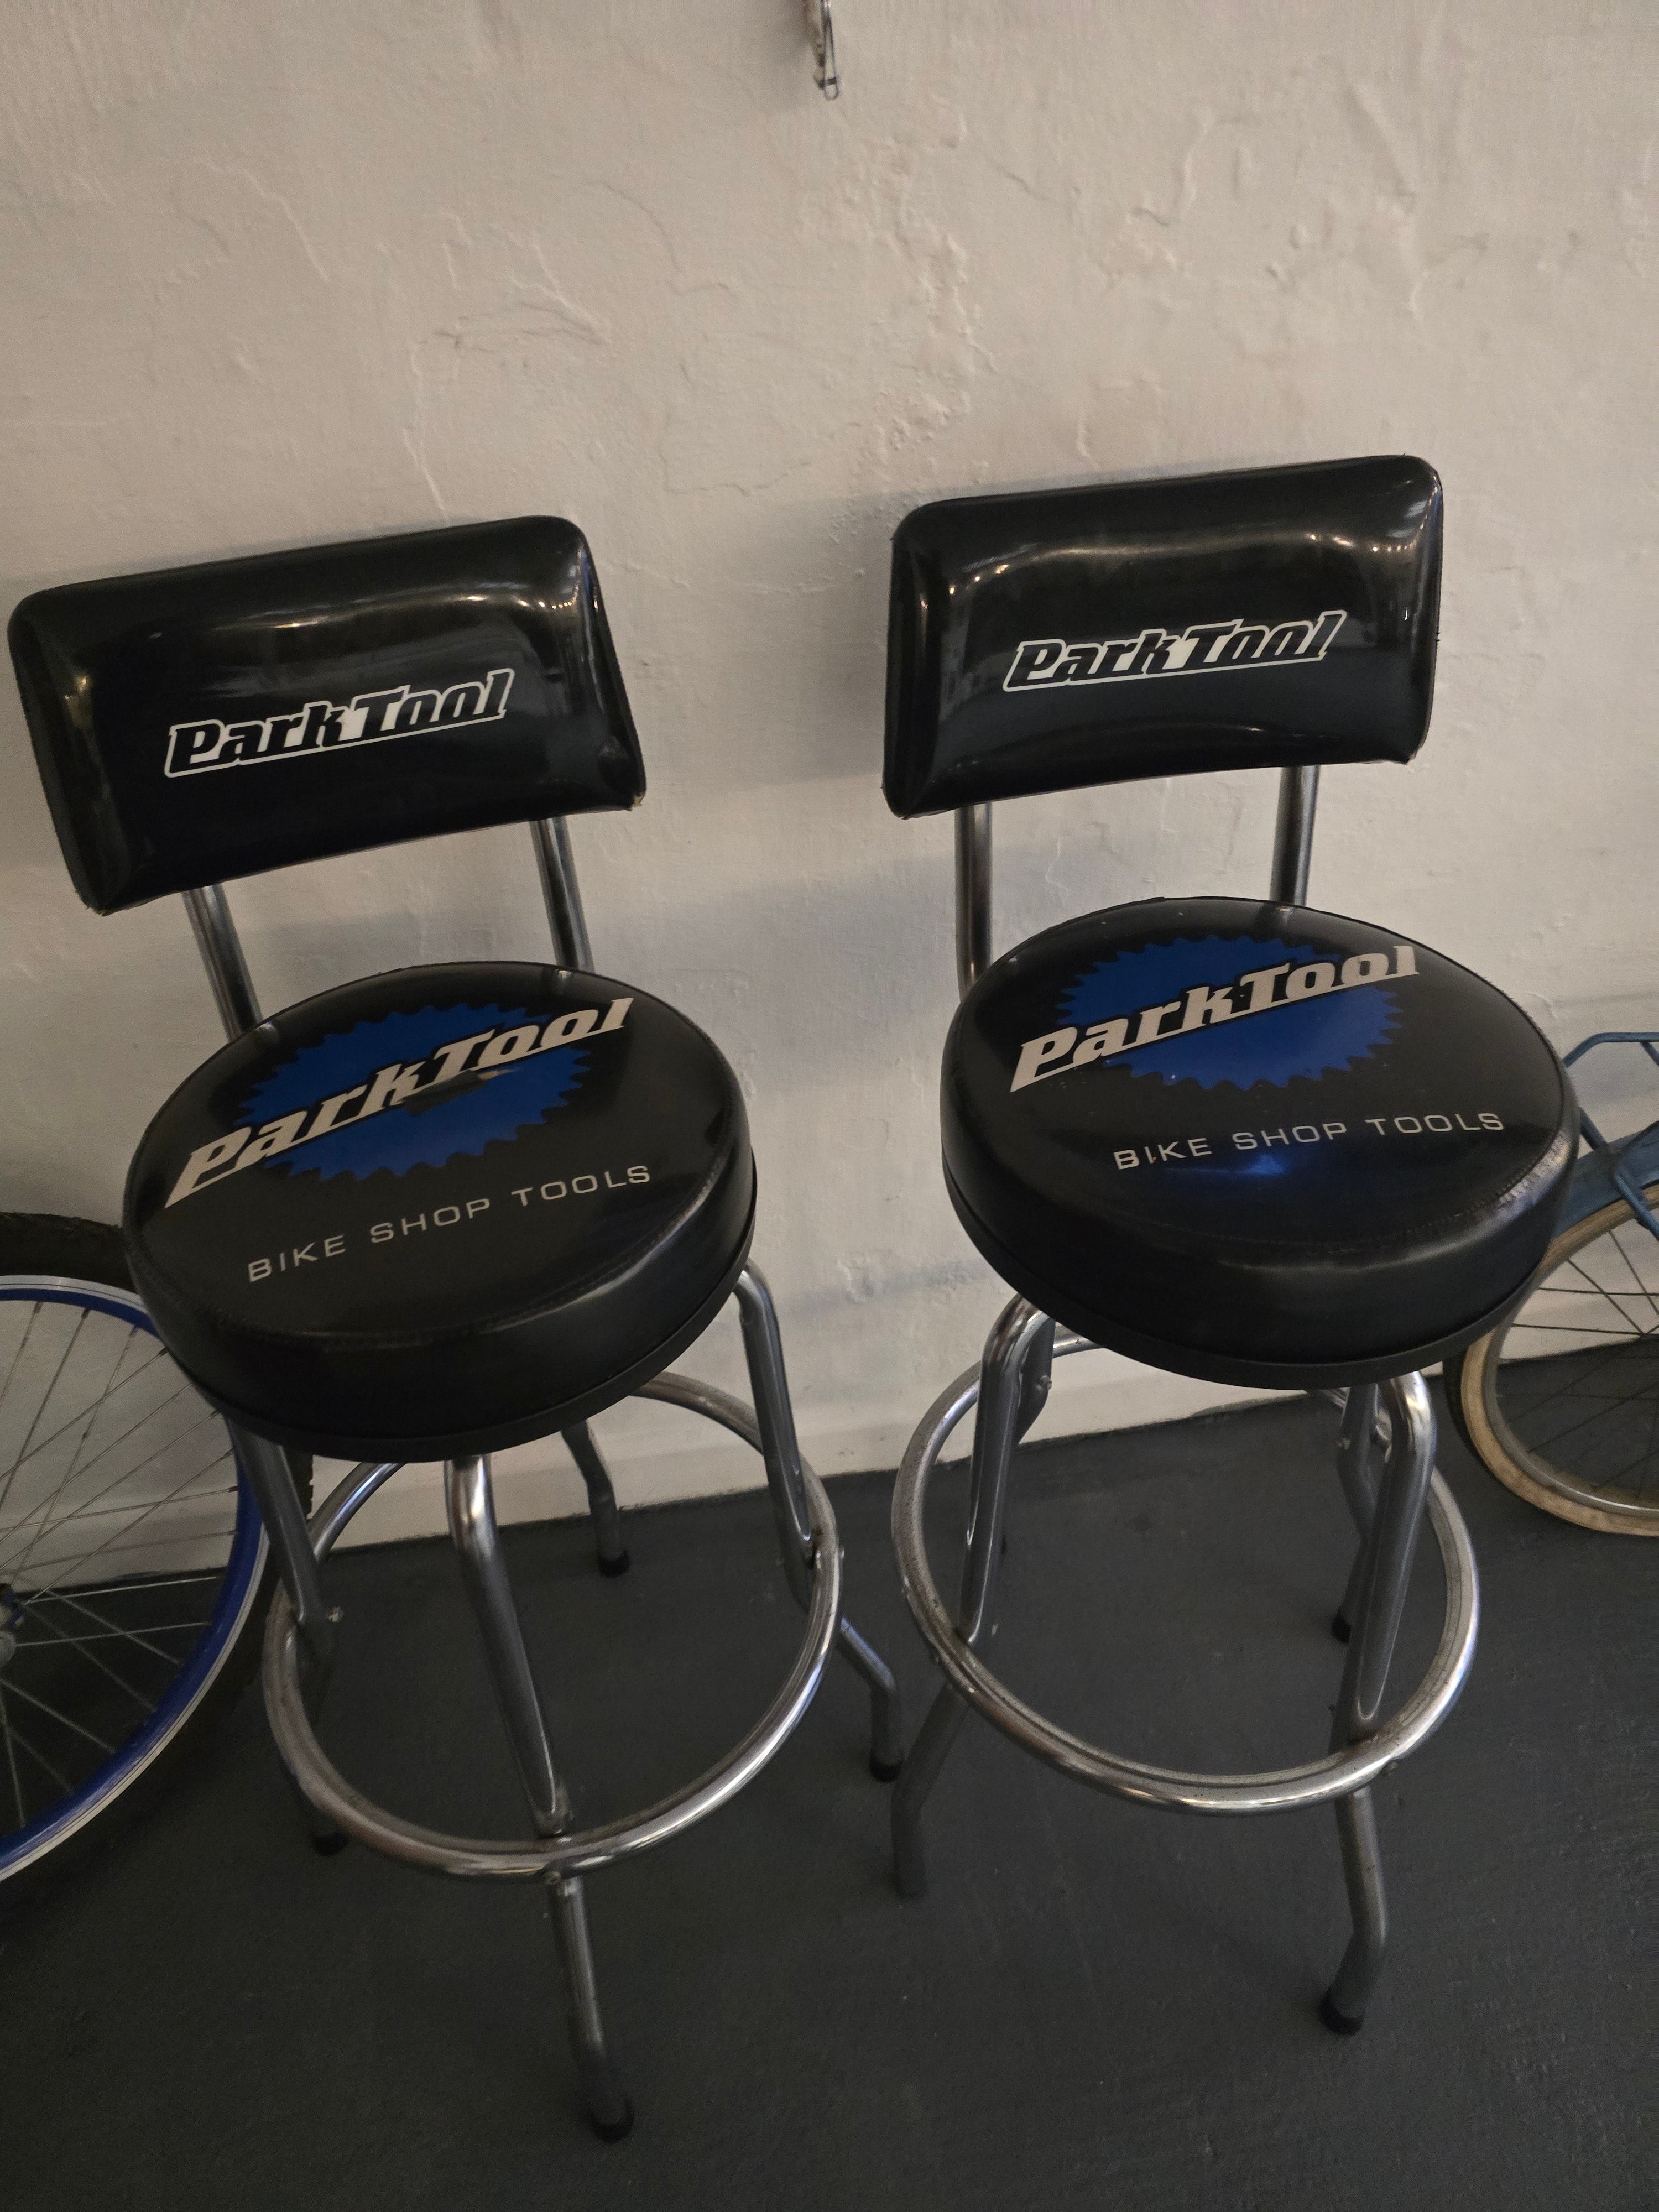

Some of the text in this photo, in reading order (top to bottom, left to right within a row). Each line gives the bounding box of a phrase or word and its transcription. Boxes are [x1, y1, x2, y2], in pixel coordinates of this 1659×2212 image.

[1113, 1112, 1504, 1170] BIKE SHOP TOOLS
[248, 1165, 650, 1282] BIKE SHOP TOOLS
